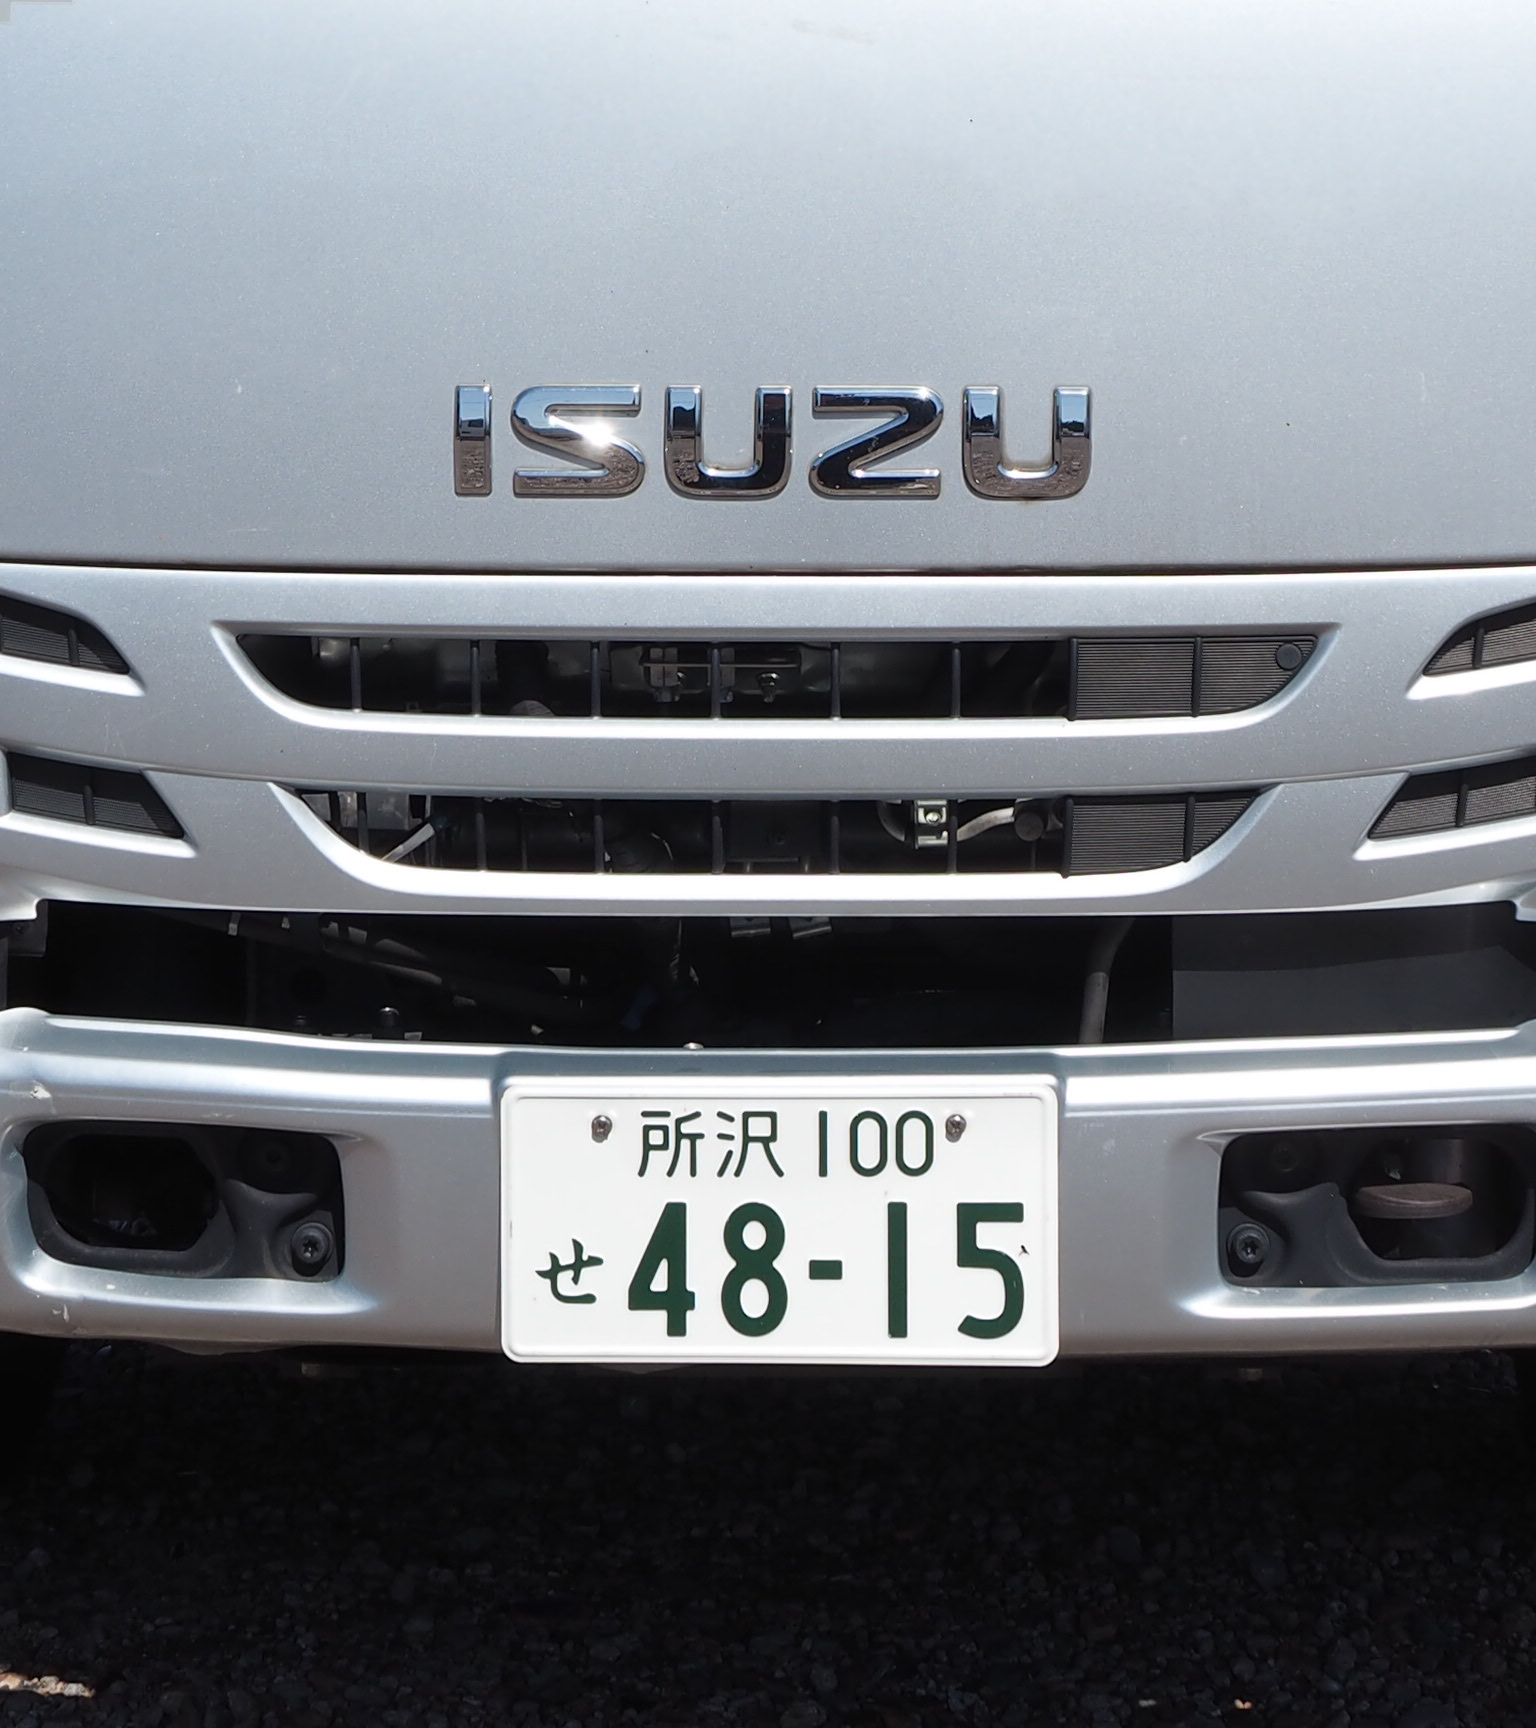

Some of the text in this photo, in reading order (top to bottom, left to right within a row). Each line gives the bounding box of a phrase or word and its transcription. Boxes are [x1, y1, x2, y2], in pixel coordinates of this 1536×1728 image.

[453, 384, 1093, 500] ISUZU
[637, 1110, 935, 1178] 所沢 100
[534, 1201, 1025, 1340] せ 48-15
